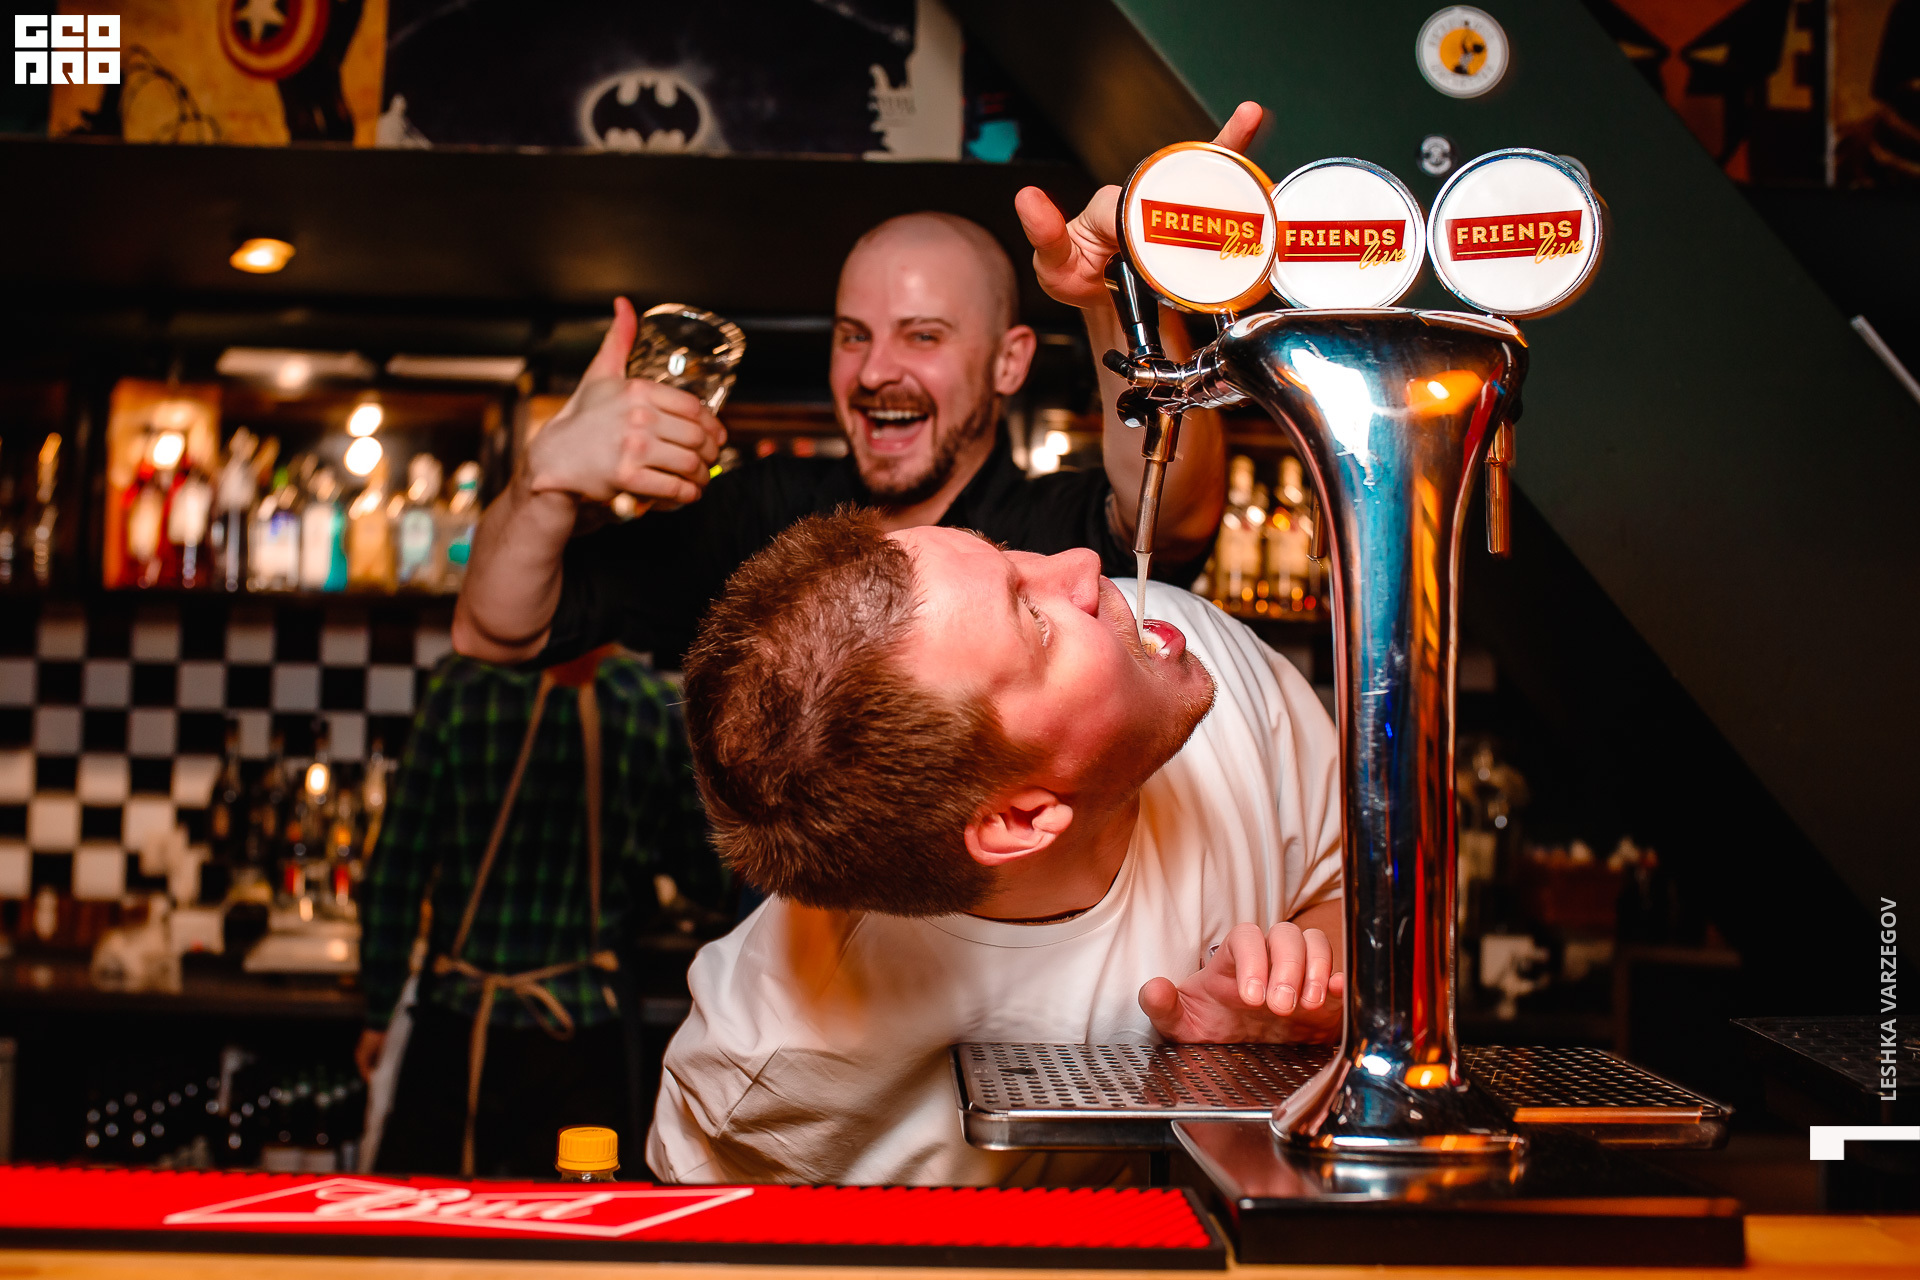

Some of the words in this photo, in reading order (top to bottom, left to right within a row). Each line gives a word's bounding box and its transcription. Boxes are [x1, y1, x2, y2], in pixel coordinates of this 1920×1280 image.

[1151, 209, 1255, 239] FRIENDS
[1285, 228, 1396, 247] FRIENDS
[1456, 219, 1573, 245] FRIENDS
[1219, 231, 1264, 261] live
[1359, 239, 1407, 270] live
[1534, 232, 1584, 264] live
[314, 1187, 614, 1220] Bud
